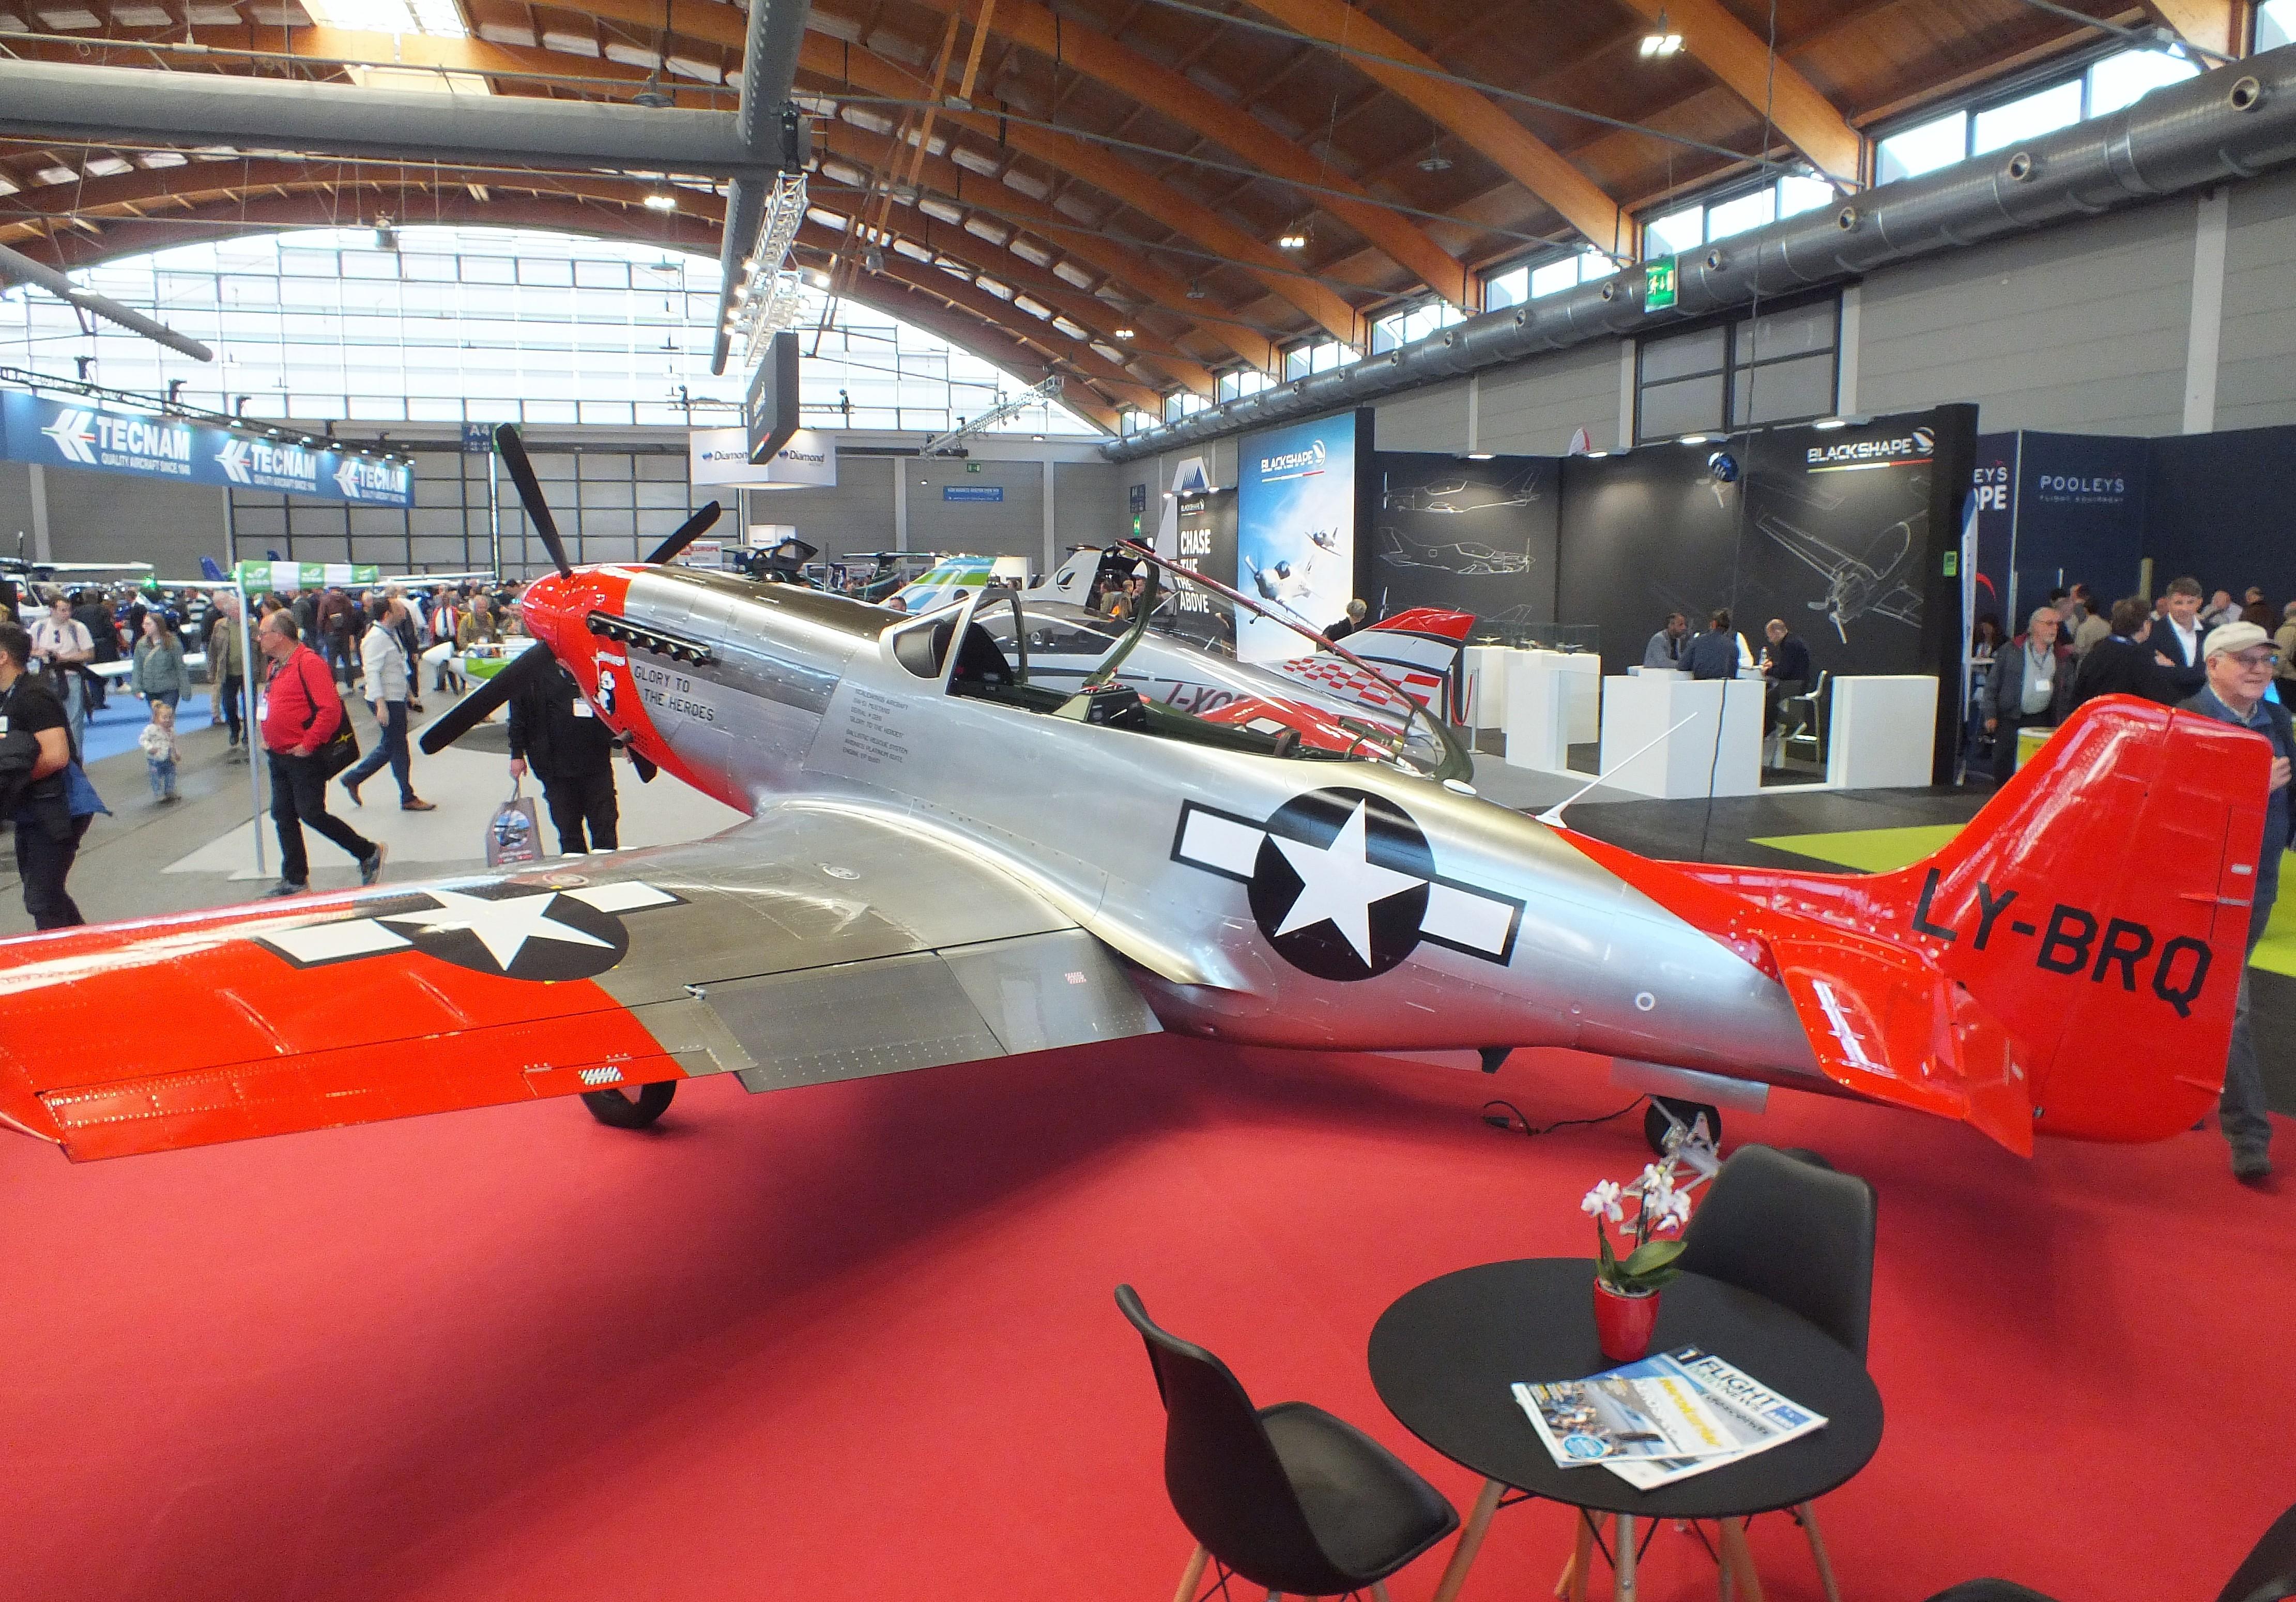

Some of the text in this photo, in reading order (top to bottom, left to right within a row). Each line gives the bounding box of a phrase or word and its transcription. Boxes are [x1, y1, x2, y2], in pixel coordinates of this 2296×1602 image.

[96, 415, 191, 461] TECNAM
[1807, 438, 1912, 463] BLACKSHAPE
[251, 443, 317, 480] TECNAM
[714, 451, 749, 460] Diamon
[790, 450, 825, 462] Diamond
[1261, 450, 1313, 473] BLACKSHAPE
[358, 463, 406, 493] TECNAM
[1973, 467, 2008, 483] EYS
[2041, 475, 2124, 493] POOLEYS
[1974, 484, 2008, 511] PE
[1180, 528, 1211, 555] CHASE
[1180, 590, 1210, 614] ABOVE
[634, 665, 691, 693] GLORY TO
[644, 689, 715, 721] THE HEROES
[1911, 867, 2214, 1019] LY-BRQ
[1699, 1359, 1781, 1406] FLIGHT
